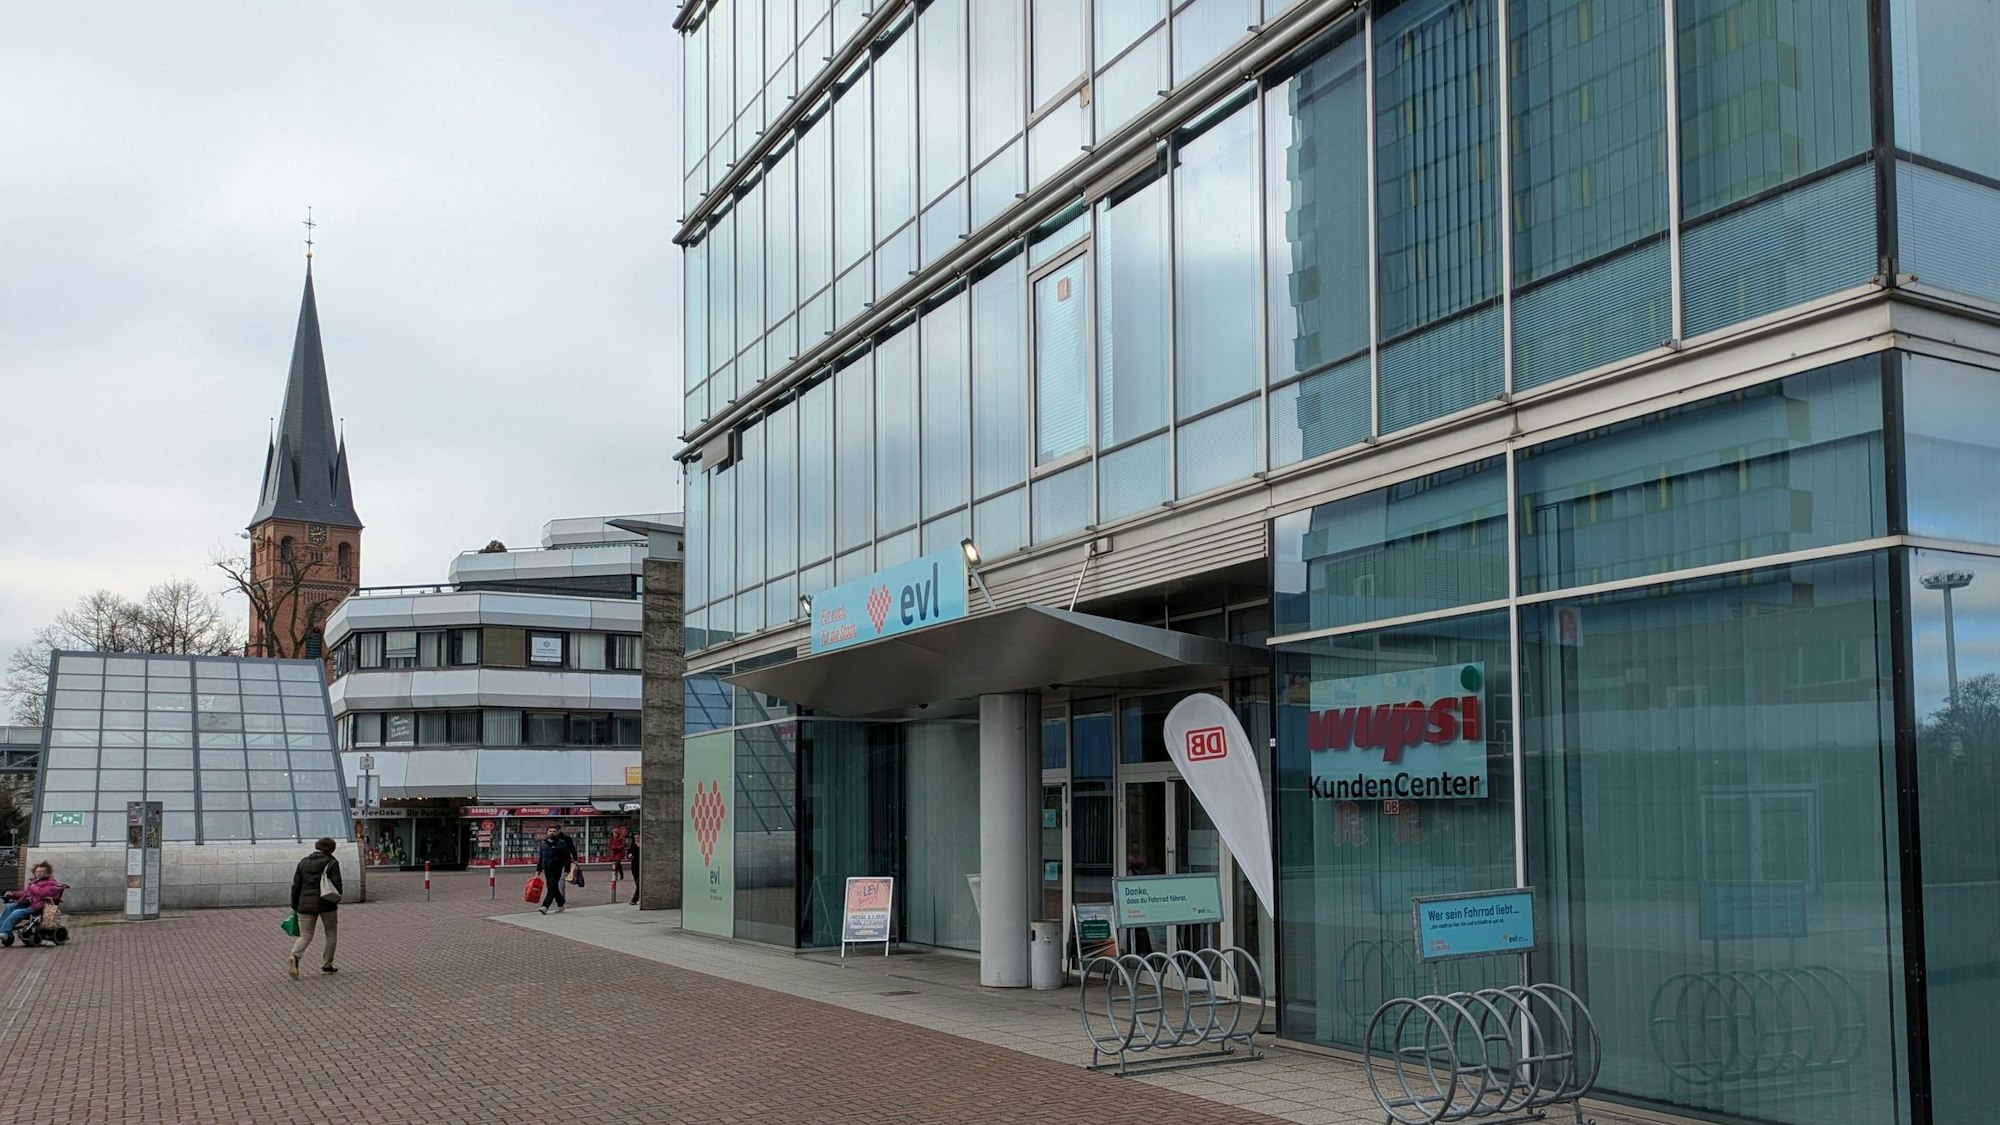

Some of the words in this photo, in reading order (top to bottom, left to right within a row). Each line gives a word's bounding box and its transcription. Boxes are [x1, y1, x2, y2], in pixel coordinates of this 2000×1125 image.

[901, 562, 939, 626] evl
[1306, 665, 1479, 762] wupsi
[1308, 771, 1480, 799] KundenCenter
[1385, 801, 1398, 813] DB
[710, 866, 720, 885] evl
[1125, 887, 1149, 897] Danke,
[1126, 897, 1140, 905] dass
[1148, 895, 1169, 903] Fahrrad
[1428, 910, 1444, 921] Wer
[1445, 908, 1462, 920] sein
[1464, 905, 1494, 918] Fahrrad
[1509, 934, 1518, 943] evl
